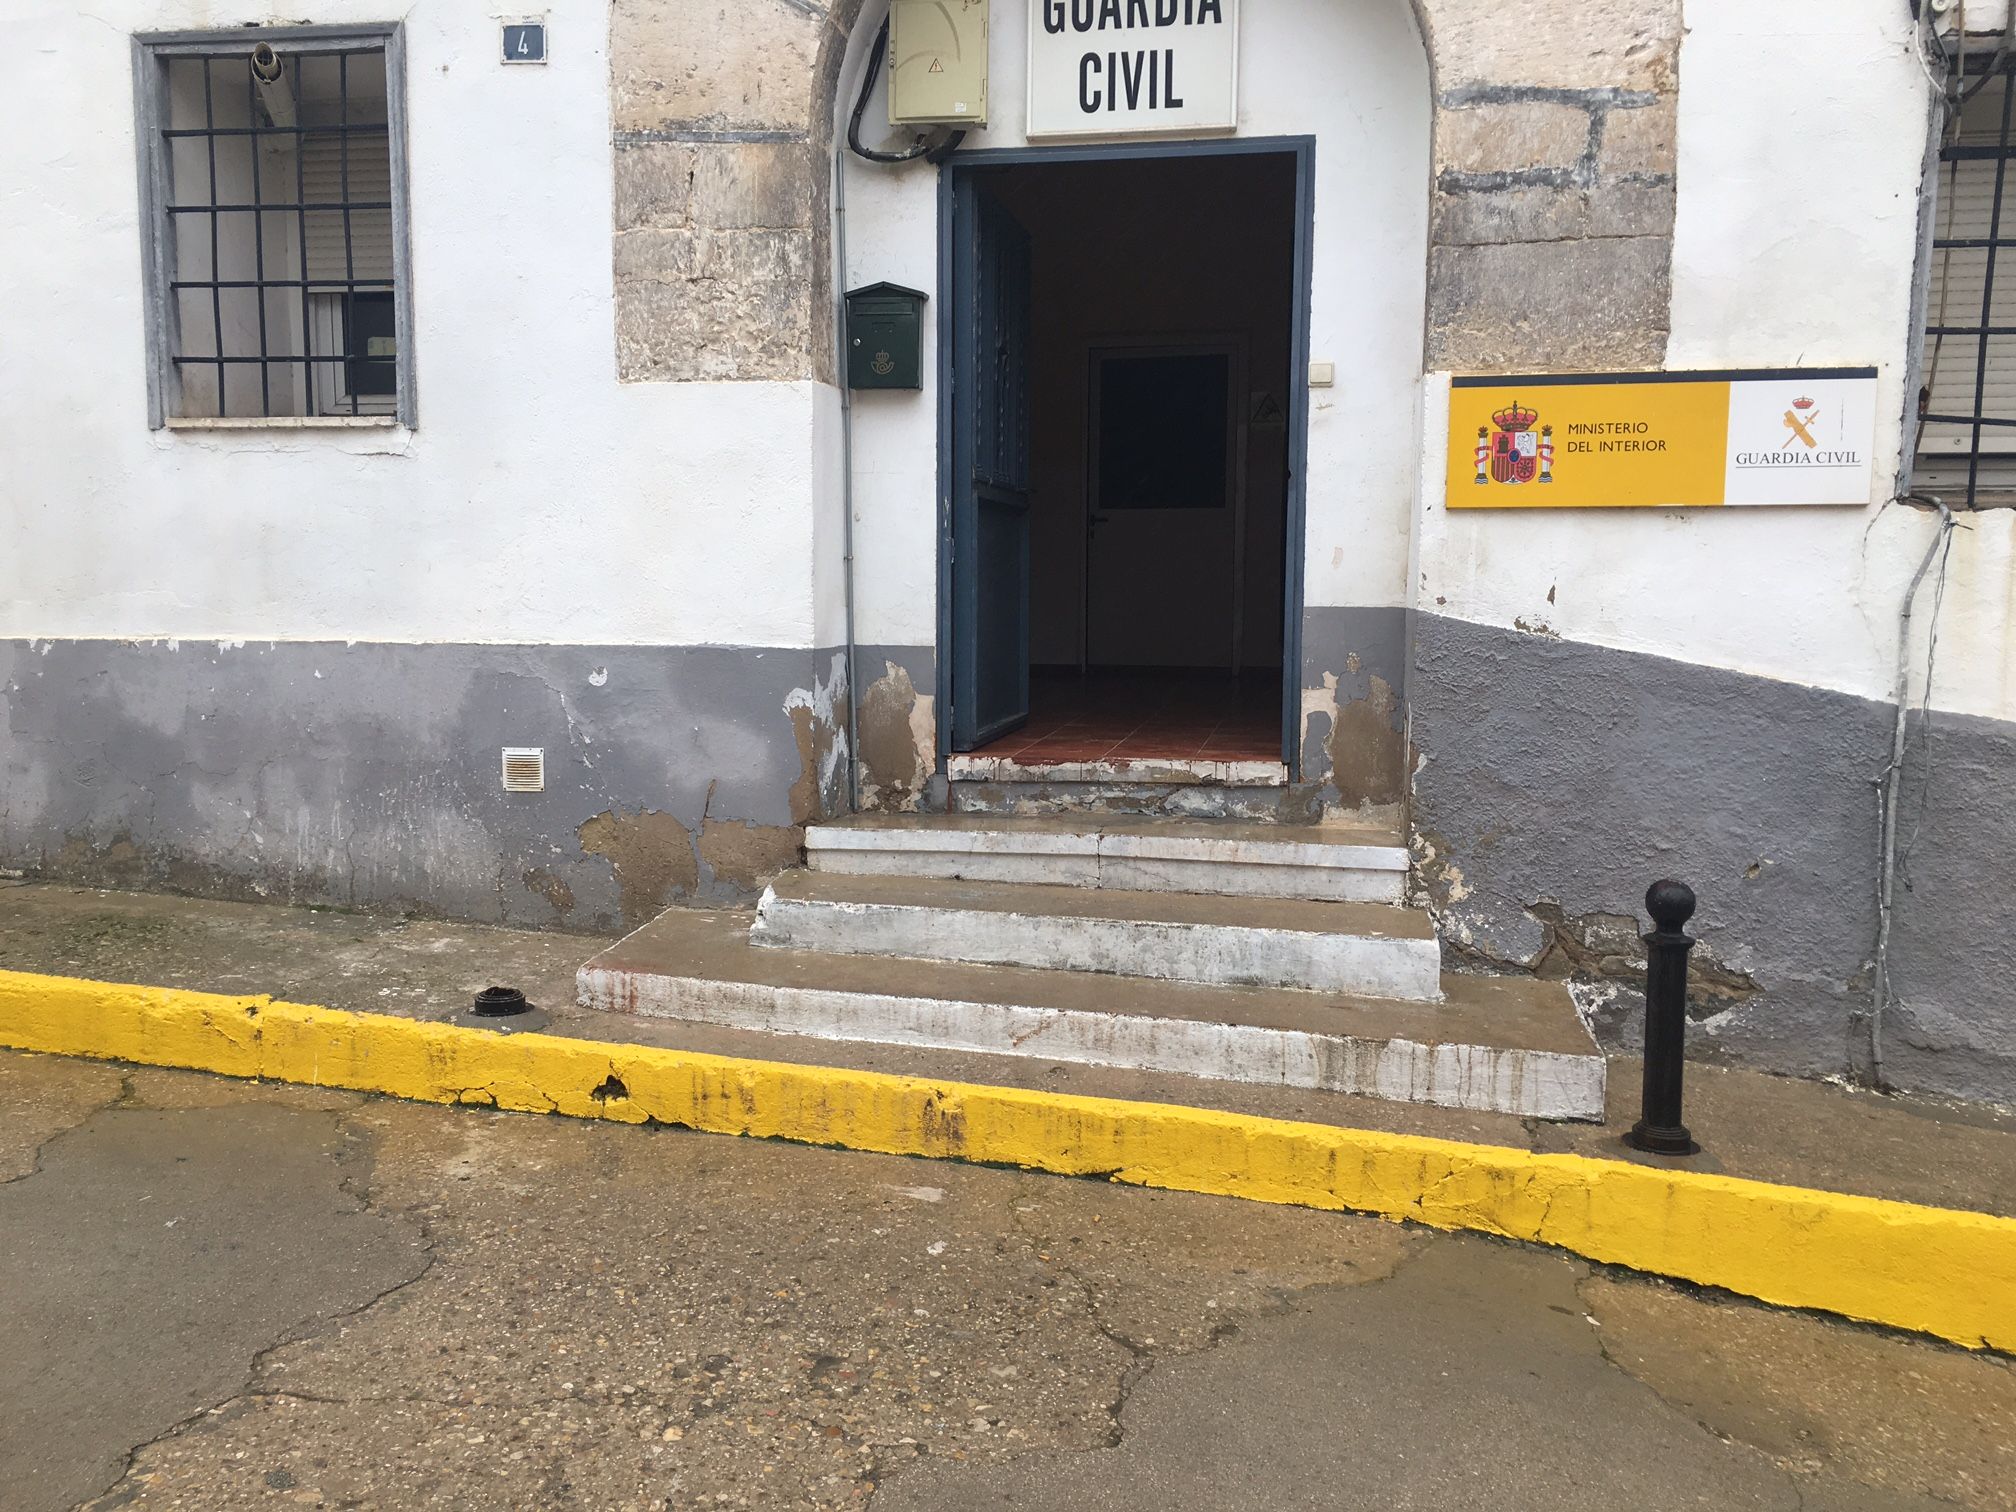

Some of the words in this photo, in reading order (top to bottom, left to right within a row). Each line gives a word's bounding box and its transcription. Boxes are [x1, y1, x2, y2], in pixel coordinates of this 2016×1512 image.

[517, 31, 529, 55] 4
[1079, 49, 1184, 114] CIVIL
[1567, 422, 1649, 435] MINISTERIO
[1567, 441, 1594, 453] DEL
[1599, 440, 1667, 452] INTERIOR
[1735, 452, 1811, 465] GUARDIA
[1816, 451, 1861, 464] CIVIL
